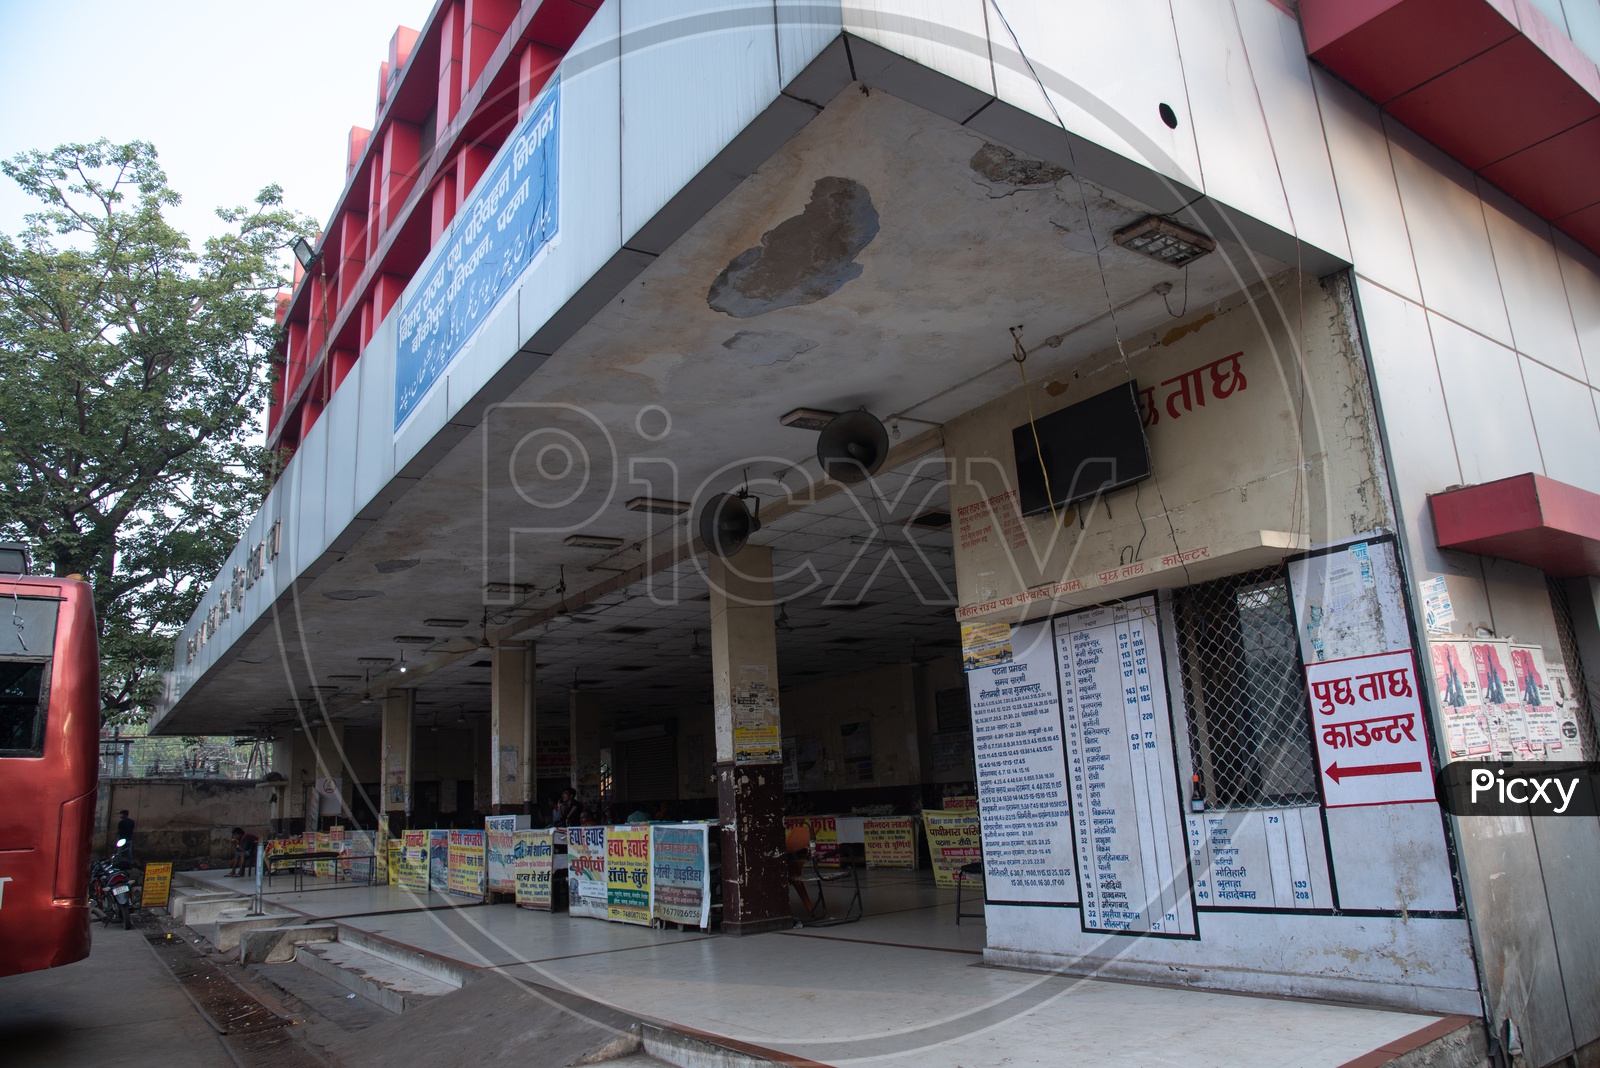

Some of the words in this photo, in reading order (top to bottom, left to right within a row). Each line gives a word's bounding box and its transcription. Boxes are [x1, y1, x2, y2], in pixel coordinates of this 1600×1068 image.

[497, 175, 530, 232] पटना
[399, 297, 422, 348] बिहार
[423, 263, 446, 312] राज्य
[447, 236, 462, 271] पथ
[465, 166, 510, 244] परिवहन
[513, 100, 556, 181] निगम
[1161, 351, 1248, 420] ताछ
[959, 602, 979, 618] बिहार
[979, 600, 997, 613] राज्य
[999, 597, 1013, 608] पथ
[1162, 546, 1211, 567] काउन्टर
[1135, 648, 1145, 656] 127
[1137, 667, 1147, 675] 141
[1355, 668, 1412, 702] ताछ
[1322, 713, 1417, 749] काउन्टर
[608, 834, 648, 860] हवा-हवाई
[1216, 866, 1247, 878] मोतिहारी
[1198, 891, 1209, 899] 40
